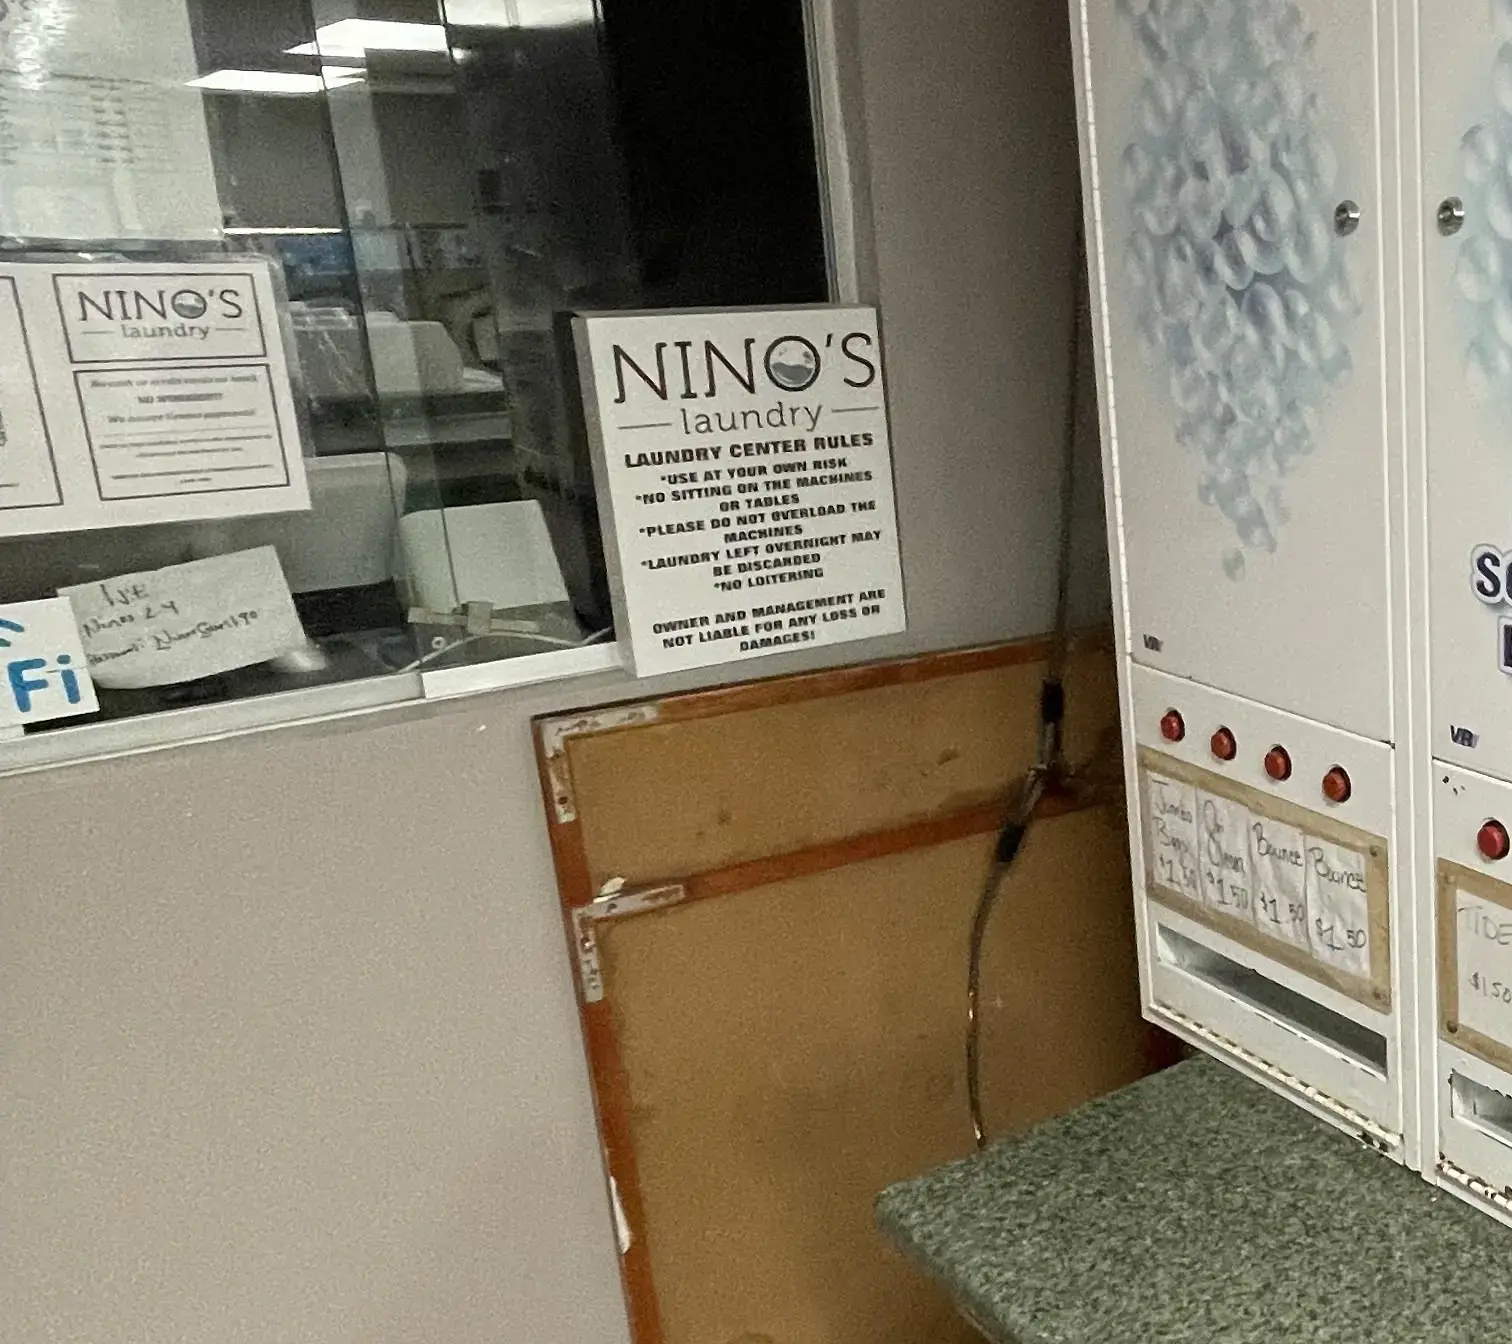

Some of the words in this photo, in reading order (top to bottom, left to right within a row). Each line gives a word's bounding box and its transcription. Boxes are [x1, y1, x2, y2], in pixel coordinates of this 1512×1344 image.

[78, 288, 243, 321] NINO'S
[121, 323, 210, 340] laundry
[612, 332, 877, 403] NINO'S
[680, 401, 823, 435] laundry
[624, 445, 722, 469] LAUNDRY
[729, 437, 806, 458] CENTER
[813, 432, 874, 450] RULES
[703, 469, 721, 481] AT
[727, 465, 768, 479] YOUR
[773, 460, 807, 474] OWN
[813, 457, 848, 470] RISK
[671, 485, 732, 502] SITTING
[737, 481, 759, 494] ON
[764, 478, 791, 491] THE
[796, 470, 873, 488] MACHINES
[710, 517, 731, 530] DO
[736, 513, 766, 527] NOT
[771, 504, 845, 522] OVERLOAD
[851, 500, 876, 512] THE
[719, 500, 740, 512] OR
[745, 493, 800, 510] TABLES
[723, 524, 803, 544] MACHINES
[725, 545, 760, 559] LEFT
[765, 534, 847, 554] OVERNIGHT
[851, 530, 882, 544] MAY
[712, 564, 732, 577] BE
[737, 552, 821, 574] DISCARDED
[747, 567, 824, 587] LOITERING
[652, 616, 710, 635] OWNER
[715, 610, 746, 624] AND
[752, 593, 854, 618] MANAGEMENT
[858, 588, 886, 602] ARE
[662, 634, 693, 649] NOT
[699, 625, 750, 645] LIABLE
[754, 620, 783, 634] FOR
[788, 614, 817, 628] ANY
[822, 608, 857, 622] LOSS
[861, 604, 880, 617] OR
[739, 630, 816, 652] DAMAGES!
[6, 653, 81, 713] Fi
